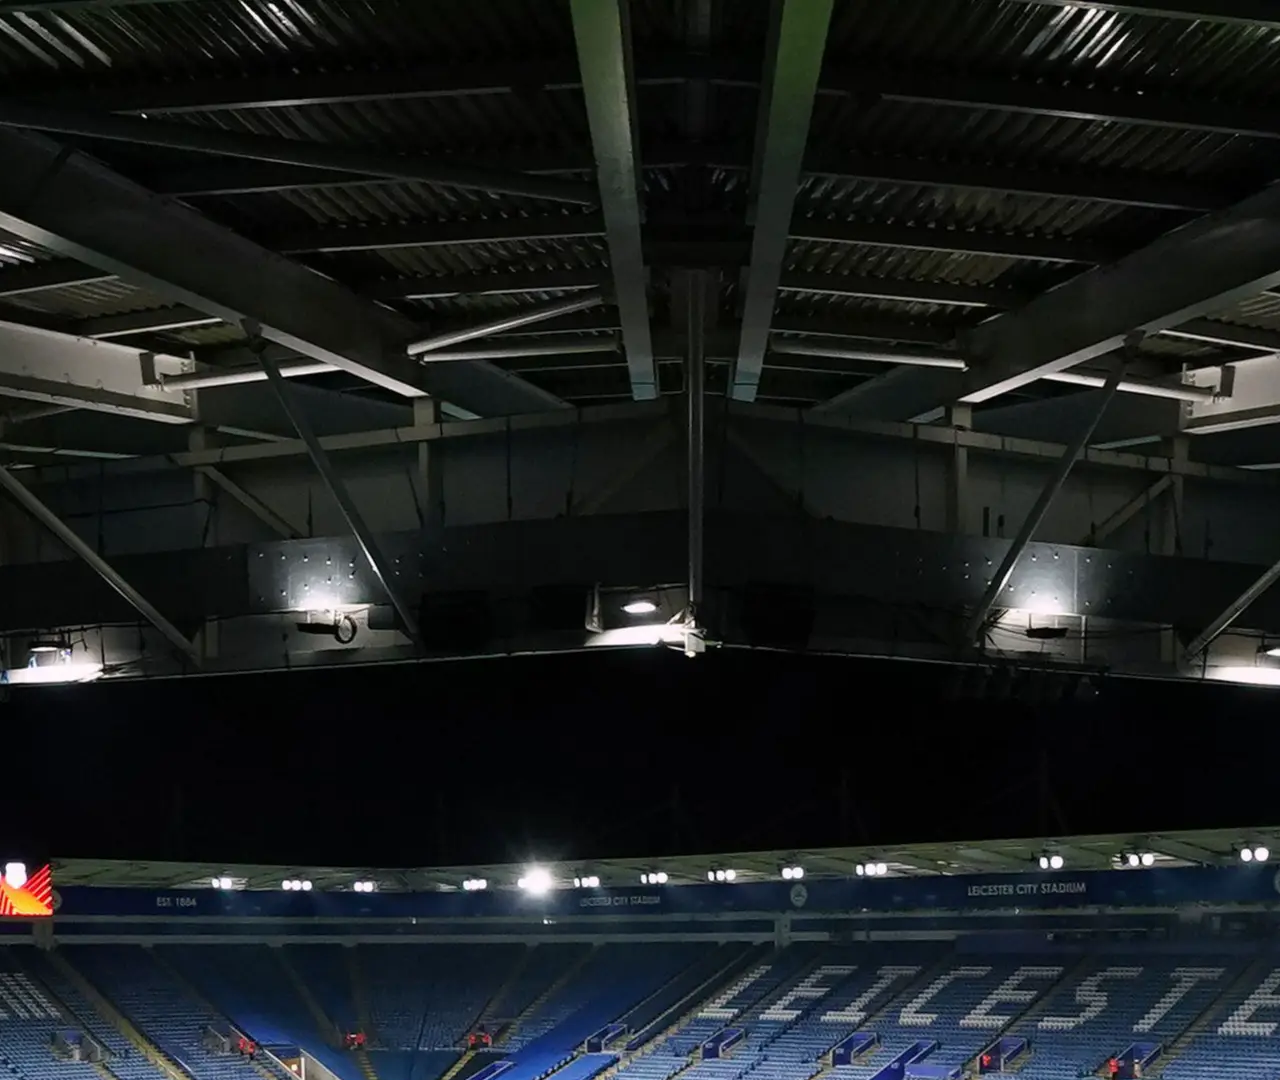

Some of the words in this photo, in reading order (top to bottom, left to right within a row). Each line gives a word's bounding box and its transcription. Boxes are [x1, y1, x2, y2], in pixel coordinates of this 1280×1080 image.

[967, 885, 1013, 896] LEICESTER
[1016, 884, 1038, 895] CITY
[1040, 882, 1086, 894] STADIUM
